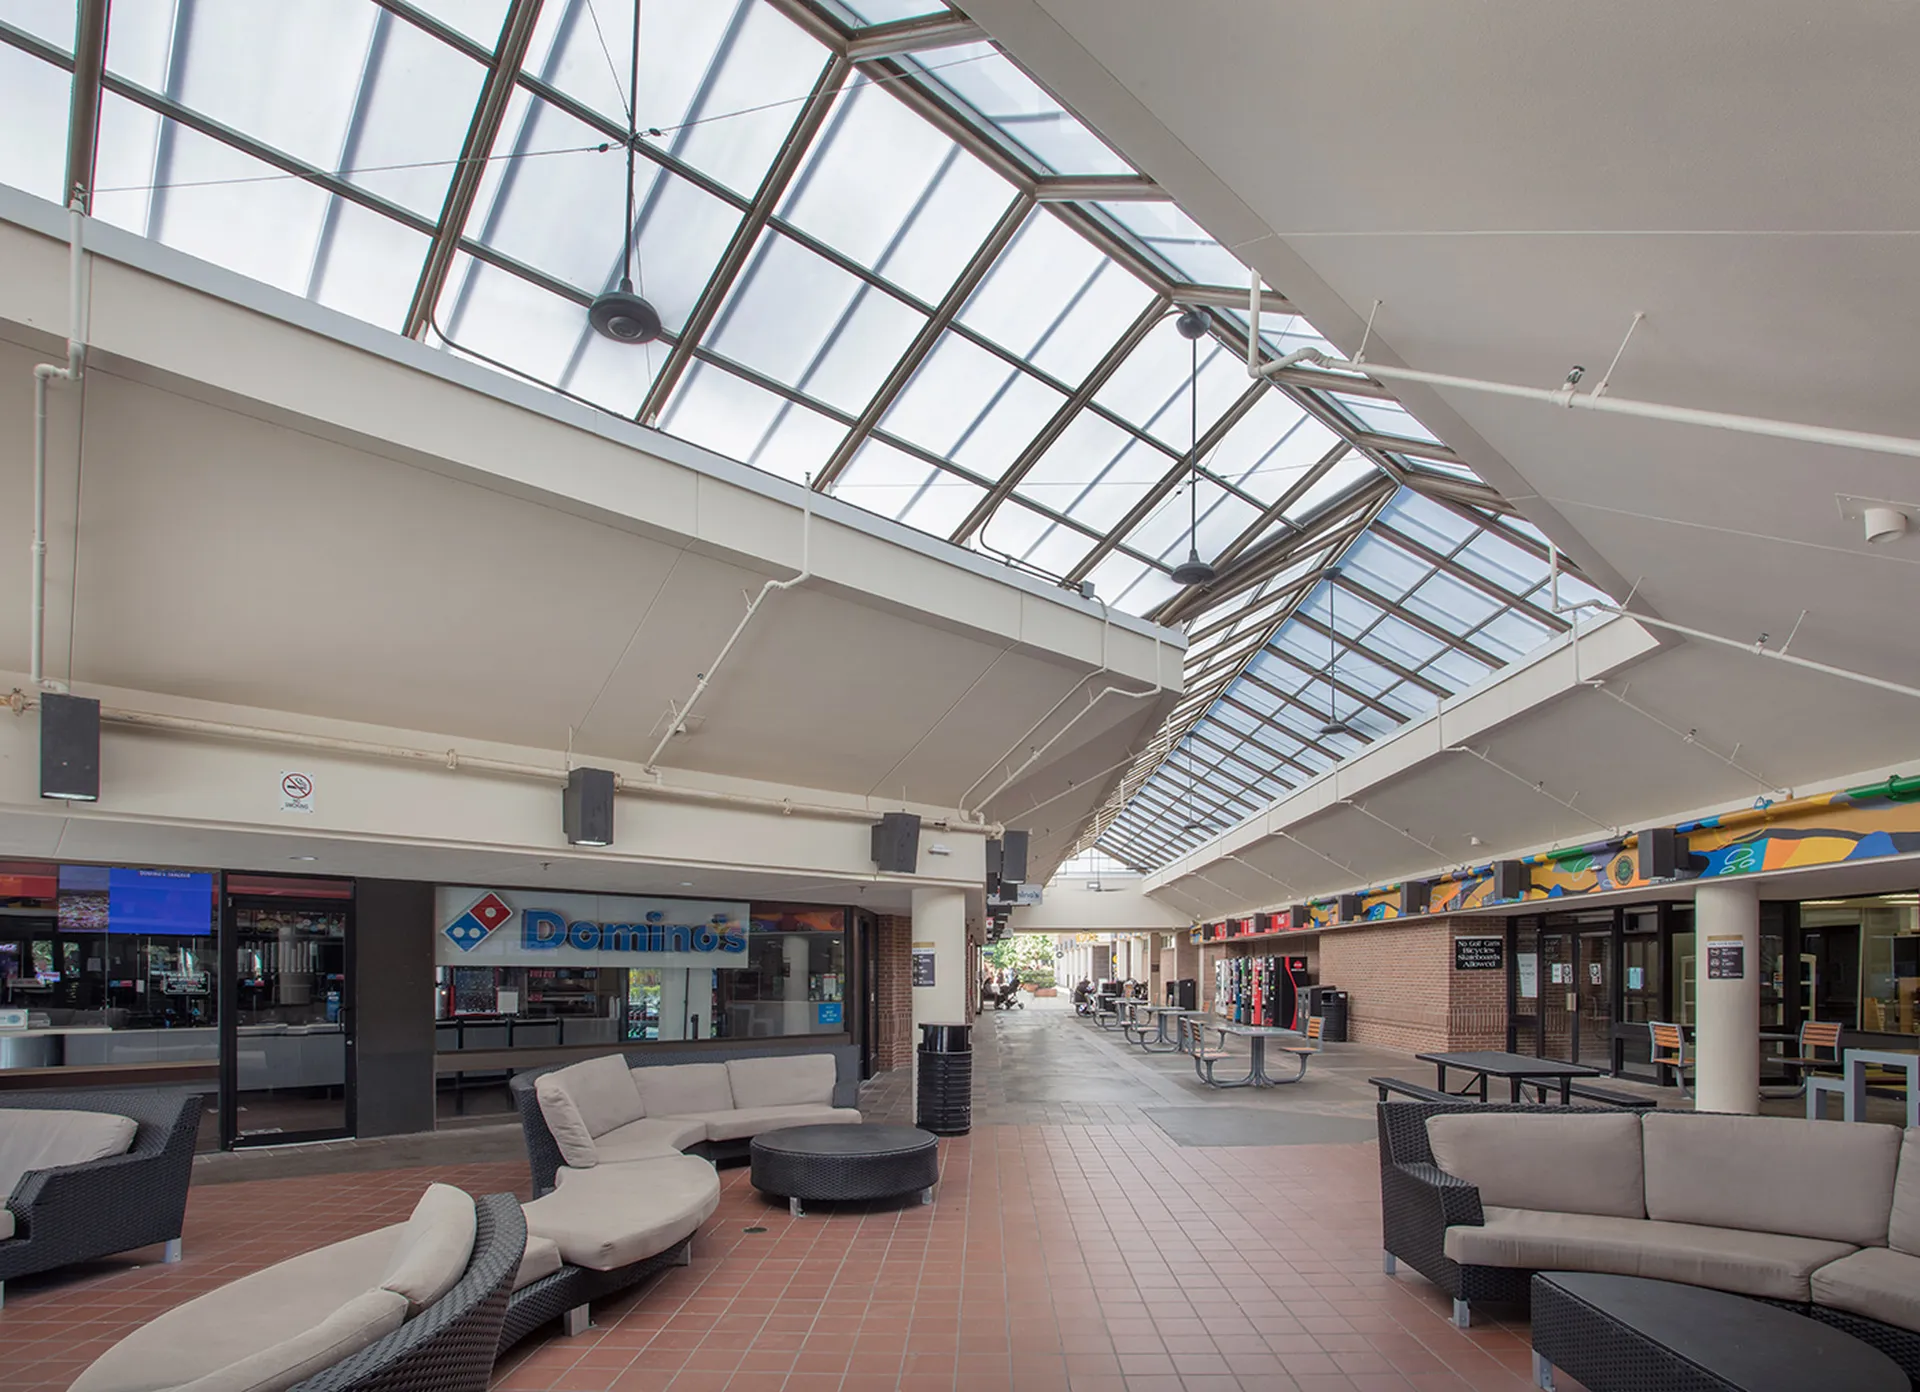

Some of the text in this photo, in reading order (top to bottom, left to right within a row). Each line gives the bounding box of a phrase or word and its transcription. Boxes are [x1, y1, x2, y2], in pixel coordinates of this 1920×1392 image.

[521, 908, 747, 953] Domino's
[1462, 947, 1496, 955] Bicycles
[1462, 960, 1496, 968] Allowed
